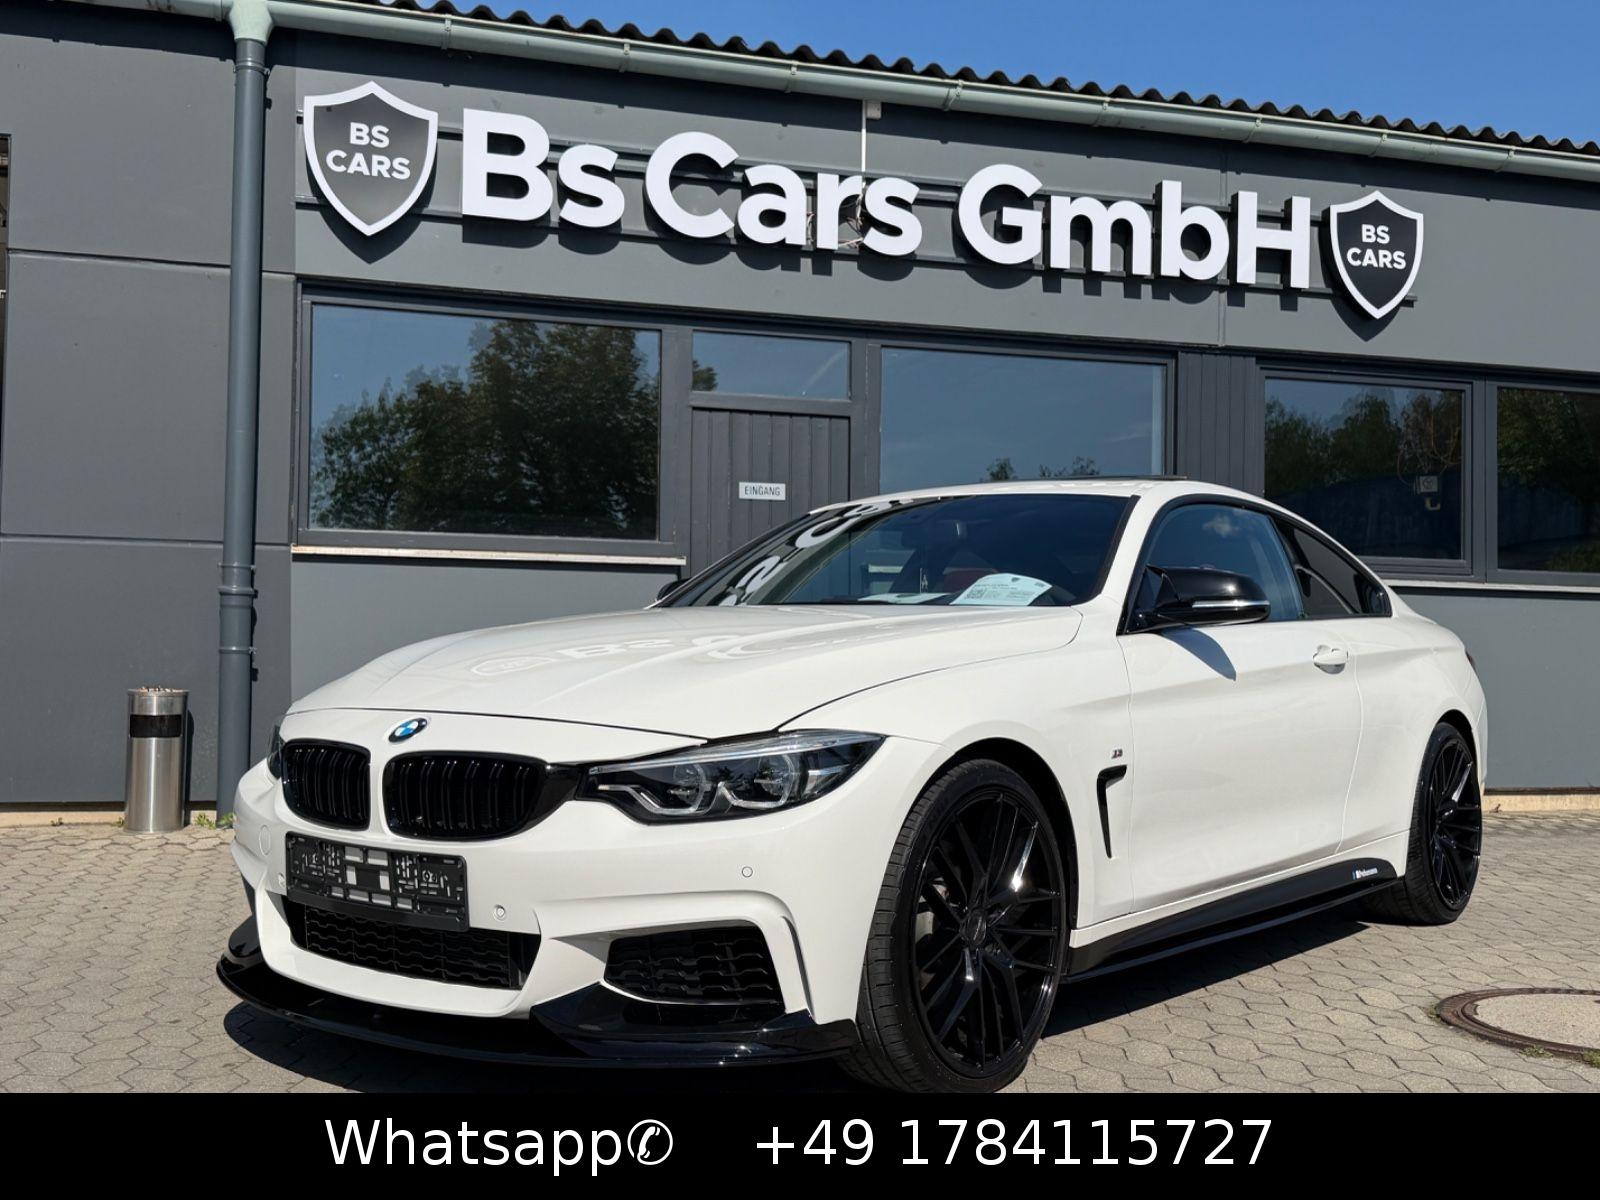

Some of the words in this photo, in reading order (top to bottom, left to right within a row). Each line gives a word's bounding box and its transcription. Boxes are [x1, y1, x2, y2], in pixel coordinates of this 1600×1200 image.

[349, 121, 390, 149] BS
[325, 149, 411, 180] CARS
[461, 108, 625, 227] Bs
[646, 131, 923, 256] Cars
[958, 164, 1311, 289] GmbH
[1361, 223, 1390, 244] BS
[1346, 247, 1407, 270] CARS
[744, 485, 781, 496] EINGANG
